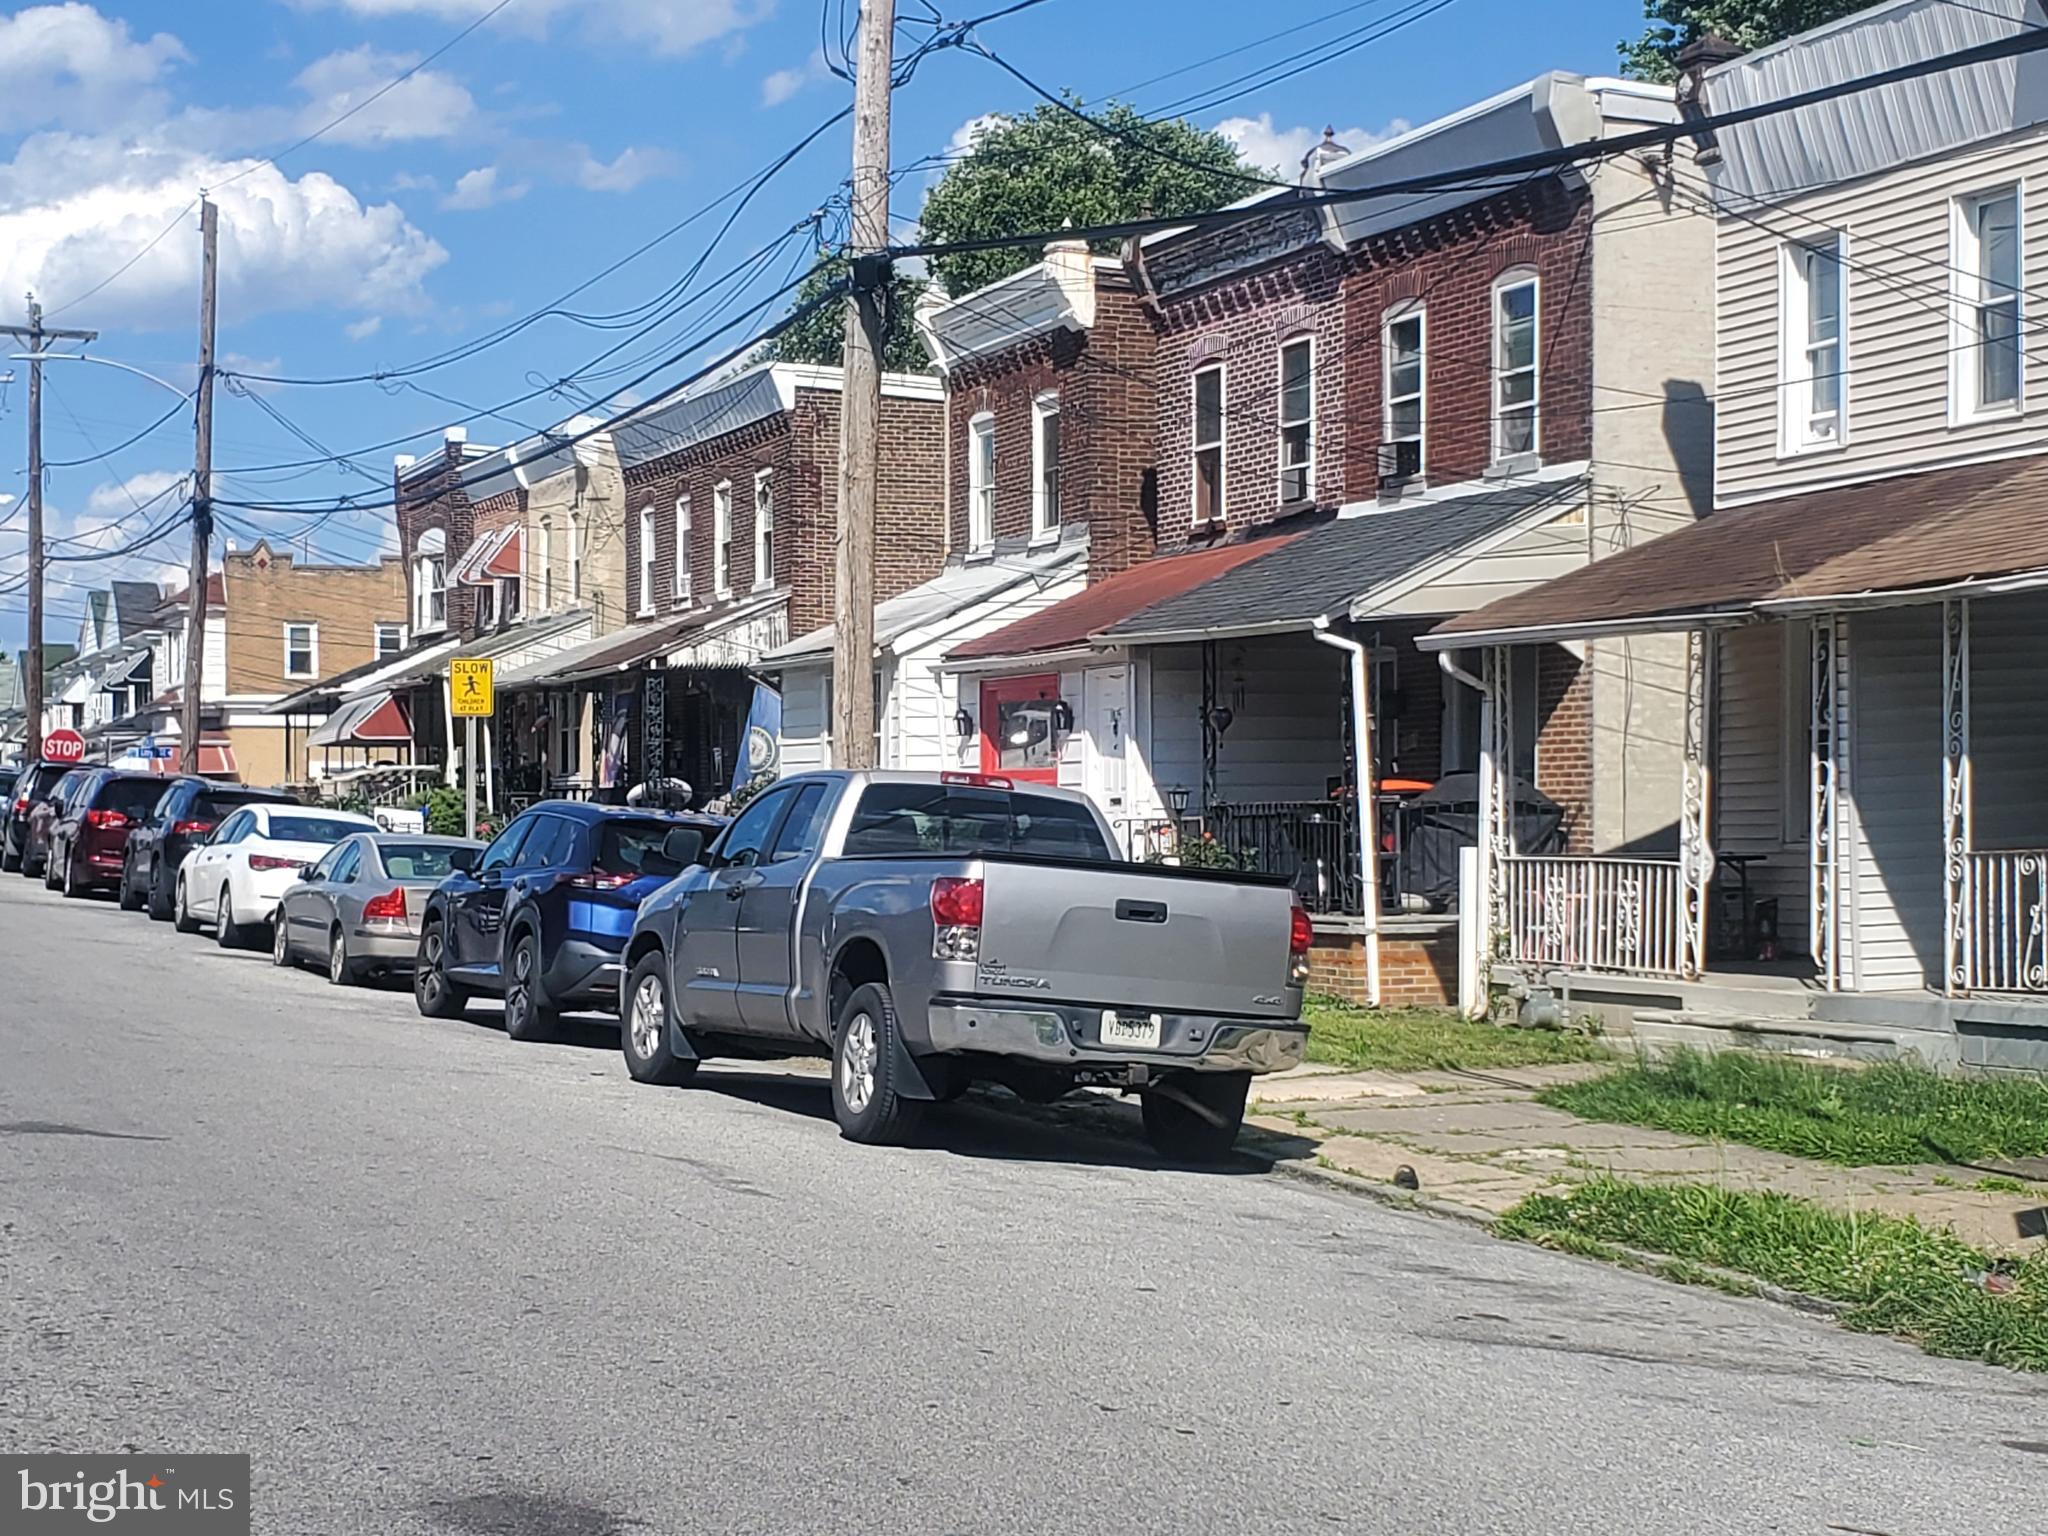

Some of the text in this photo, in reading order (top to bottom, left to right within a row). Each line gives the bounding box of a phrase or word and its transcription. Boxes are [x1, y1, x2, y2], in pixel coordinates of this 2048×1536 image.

[454, 663, 488, 673] SLOW
[46, 740, 82, 757] STOP
[979, 975, 1051, 989] TUNDRA
